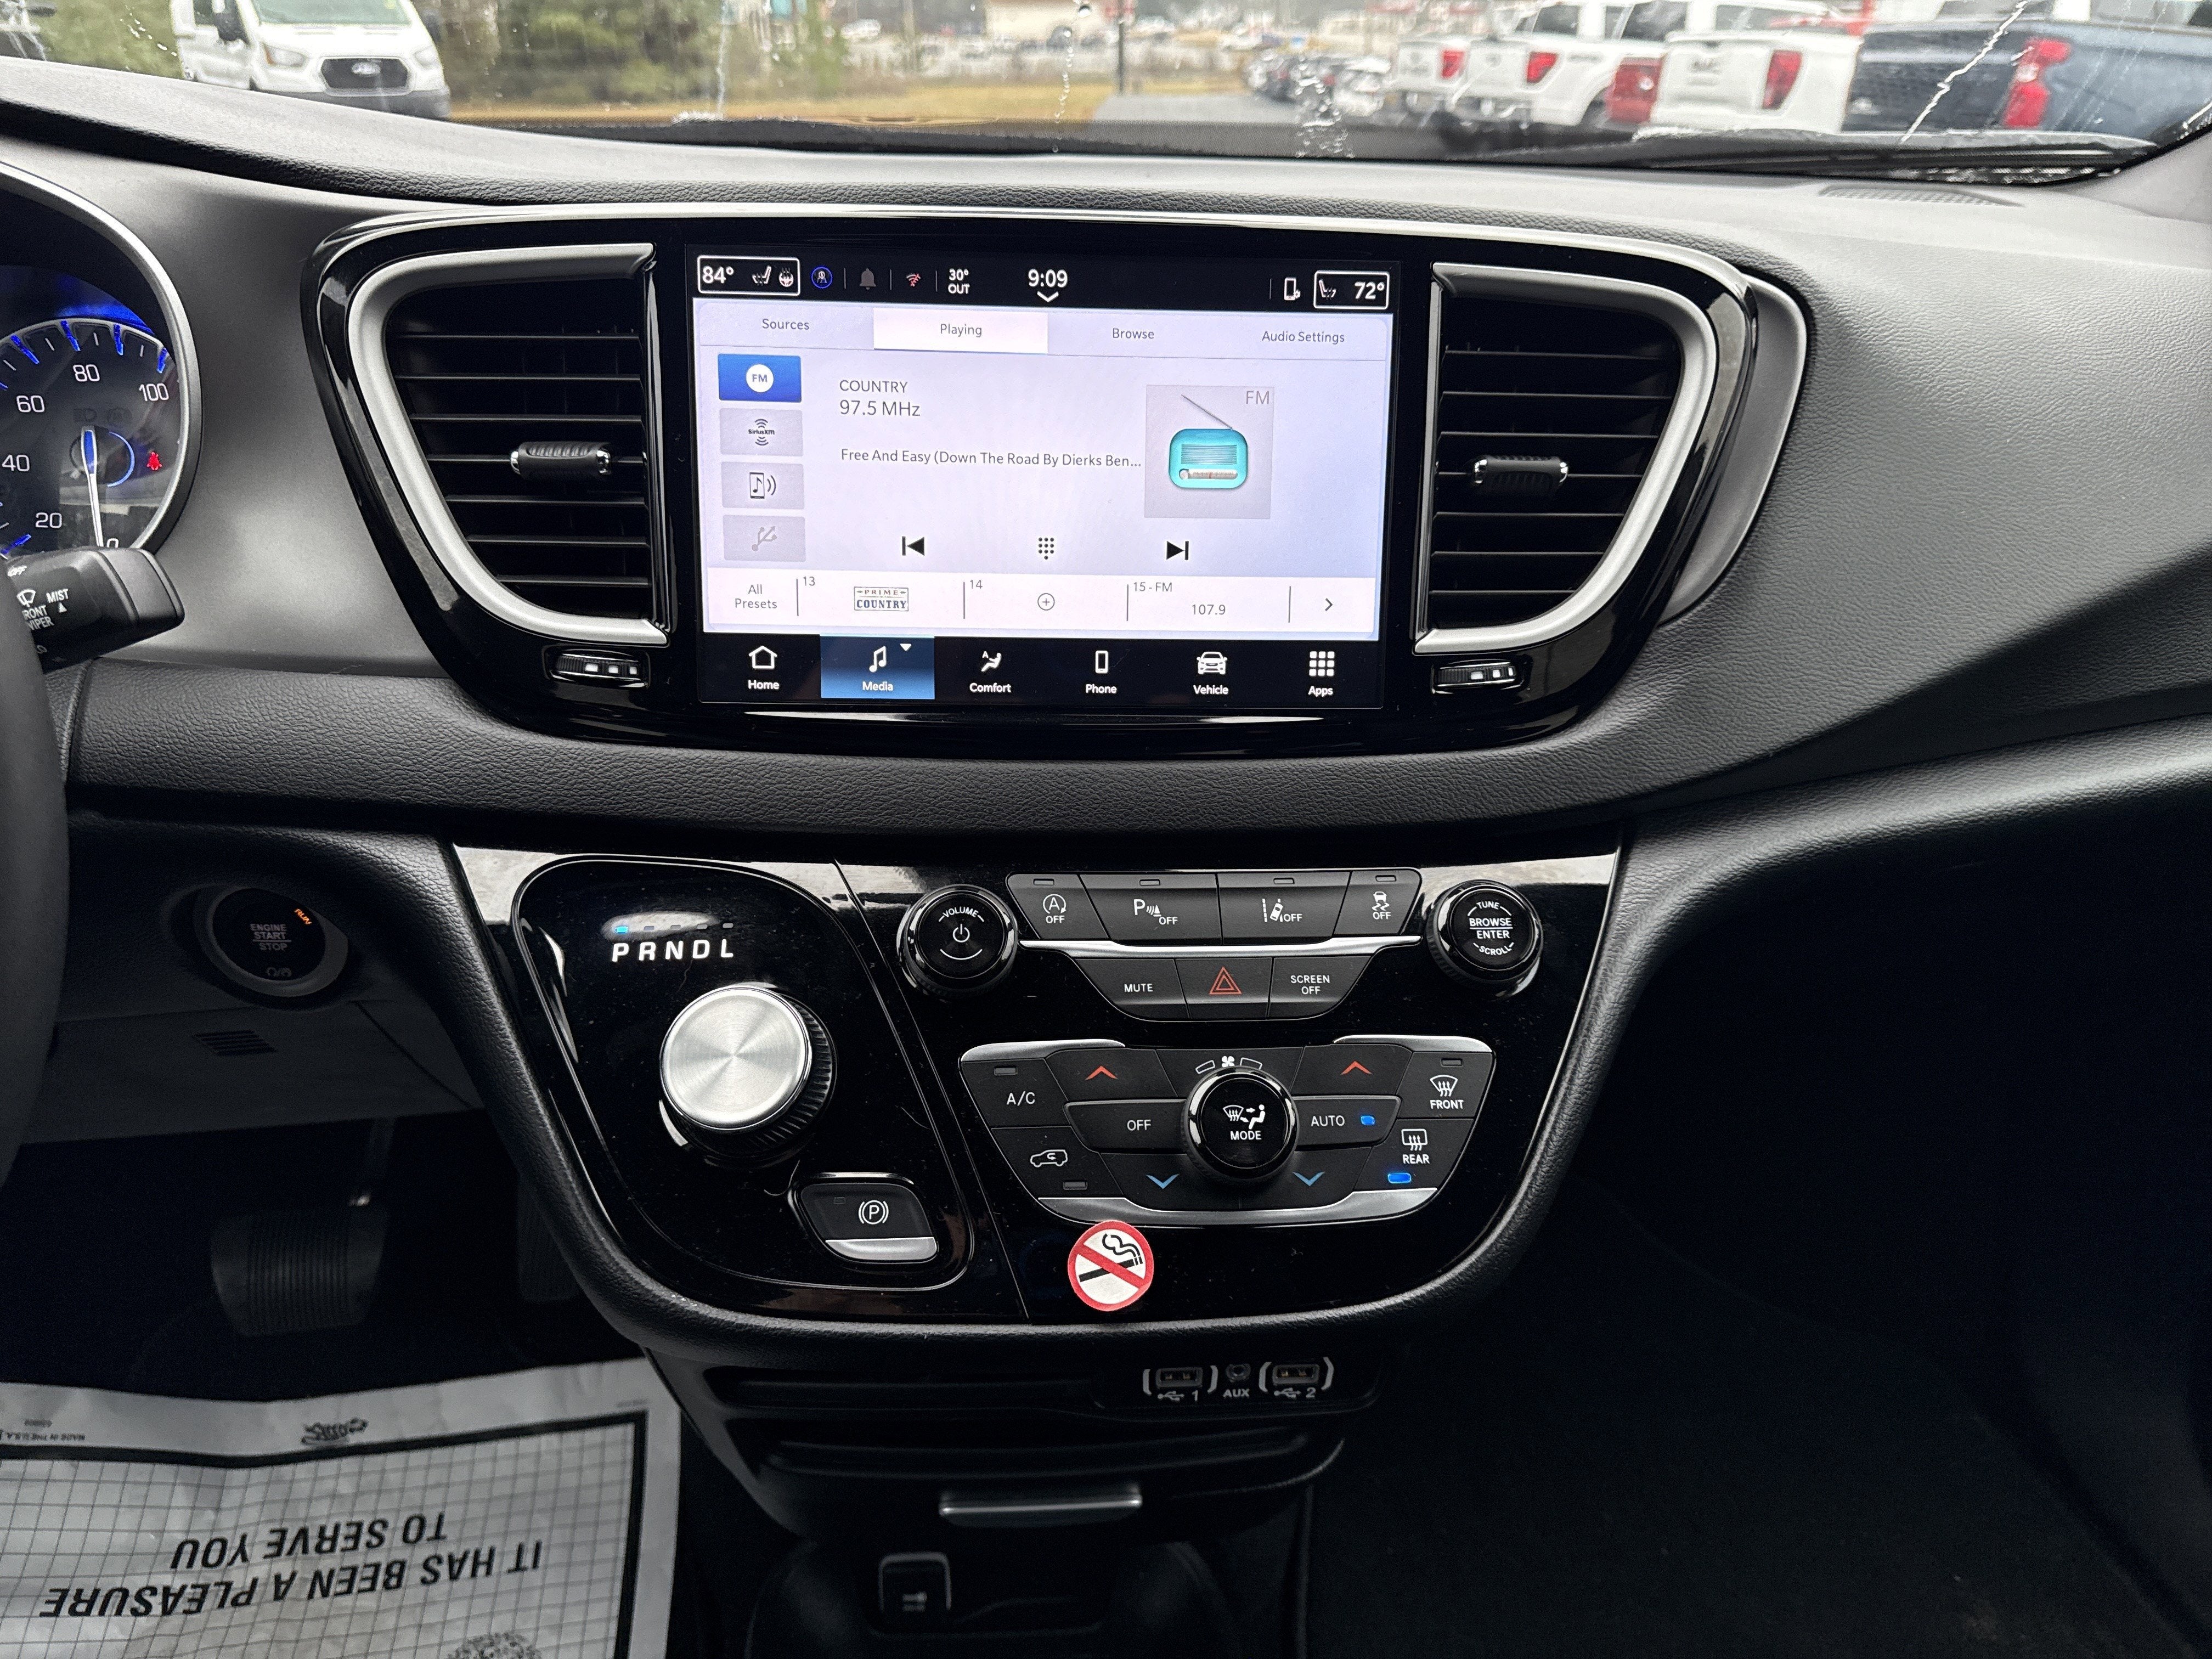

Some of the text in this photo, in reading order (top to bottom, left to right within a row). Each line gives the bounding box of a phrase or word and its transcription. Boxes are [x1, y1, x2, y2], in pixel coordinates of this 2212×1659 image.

[702, 266, 735, 284] 84°
[947, 268, 969, 281] 30°
[1028, 269, 1068, 287] 9:09
[947, 283, 970, 295] OUT
[1353, 281, 1385, 300] 72°
[761, 318, 810, 331] Sources
[939, 323, 983, 338] Playing
[1112, 327, 1155, 340] Browse
[1261, 330, 1345, 345] Audio Settings
[72, 364, 100, 382] 80
[751, 373, 768, 383] FM
[839, 379, 908, 393] COUNTRY
[138, 383, 170, 402] 100
[1245, 390, 1270, 405] FM
[16, 395, 45, 413] 60
[839, 399, 921, 417] 97.5 MHz
[1, 454, 30, 472] 40
[841, 448, 1142, 467] Free And Easy (Down The Road By Dierks Ben...
[35, 512, 63, 529] 20
[802, 576, 815, 587] 13
[969, 579, 983, 590] 14
[1132, 582, 1146, 592] 15
[1155, 582, 1173, 592] FM
[748, 584, 763, 595] All
[46, 589, 69, 603] MIST
[734, 597, 778, 611] Presets
[856, 599, 907, 610] COUNTRY
[22, 605, 48, 620] RONT
[1191, 604, 1226, 616] 107.9
[748, 680, 780, 690] Home
[862, 681, 894, 692] Media
[969, 682, 1012, 693] Comfort
[1085, 684, 1117, 695] Phone
[1193, 685, 1229, 695] Vehicle
[1308, 686, 1333, 697] Apps
[1476, 901, 1499, 911] TUNE
[943, 907, 978, 918] VOLUME
[1283, 913, 1303, 922] OFF
[1372, 911, 1391, 921] OFF
[1046, 915, 1065, 924] OFF
[1159, 916, 1178, 925] OFF
[1469, 917, 1512, 927] BROWSE
[250, 923, 287, 932] ENGINE
[253, 932, 287, 940] START
[1476, 930, 1510, 939] ENTER
[258, 943, 288, 951] STOP
[1480, 945, 1511, 956] SCROLL
[1290, 974, 1330, 984] SCREEN
[1124, 984, 1153, 993] MUTE
[1301, 986, 1321, 995] OFF
[1006, 1091, 1036, 1106] A/C
[1430, 1099, 1464, 1110] FRONT
[1127, 1119, 1152, 1131] OFF
[1311, 1115, 1345, 1127] AUTO
[1230, 1130, 1262, 1141] MODE
[1402, 1154, 1430, 1165] REAR
[1192, 1390, 1199, 1401] 1
[1222, 1388, 1250, 1398] AUX
[1305, 1387, 1317, 1398] 2
[169, 1511, 448, 1571] TO SERVE YOU
[41, 1538, 543, 1617] IT HAS BEEN A PLEASURE
